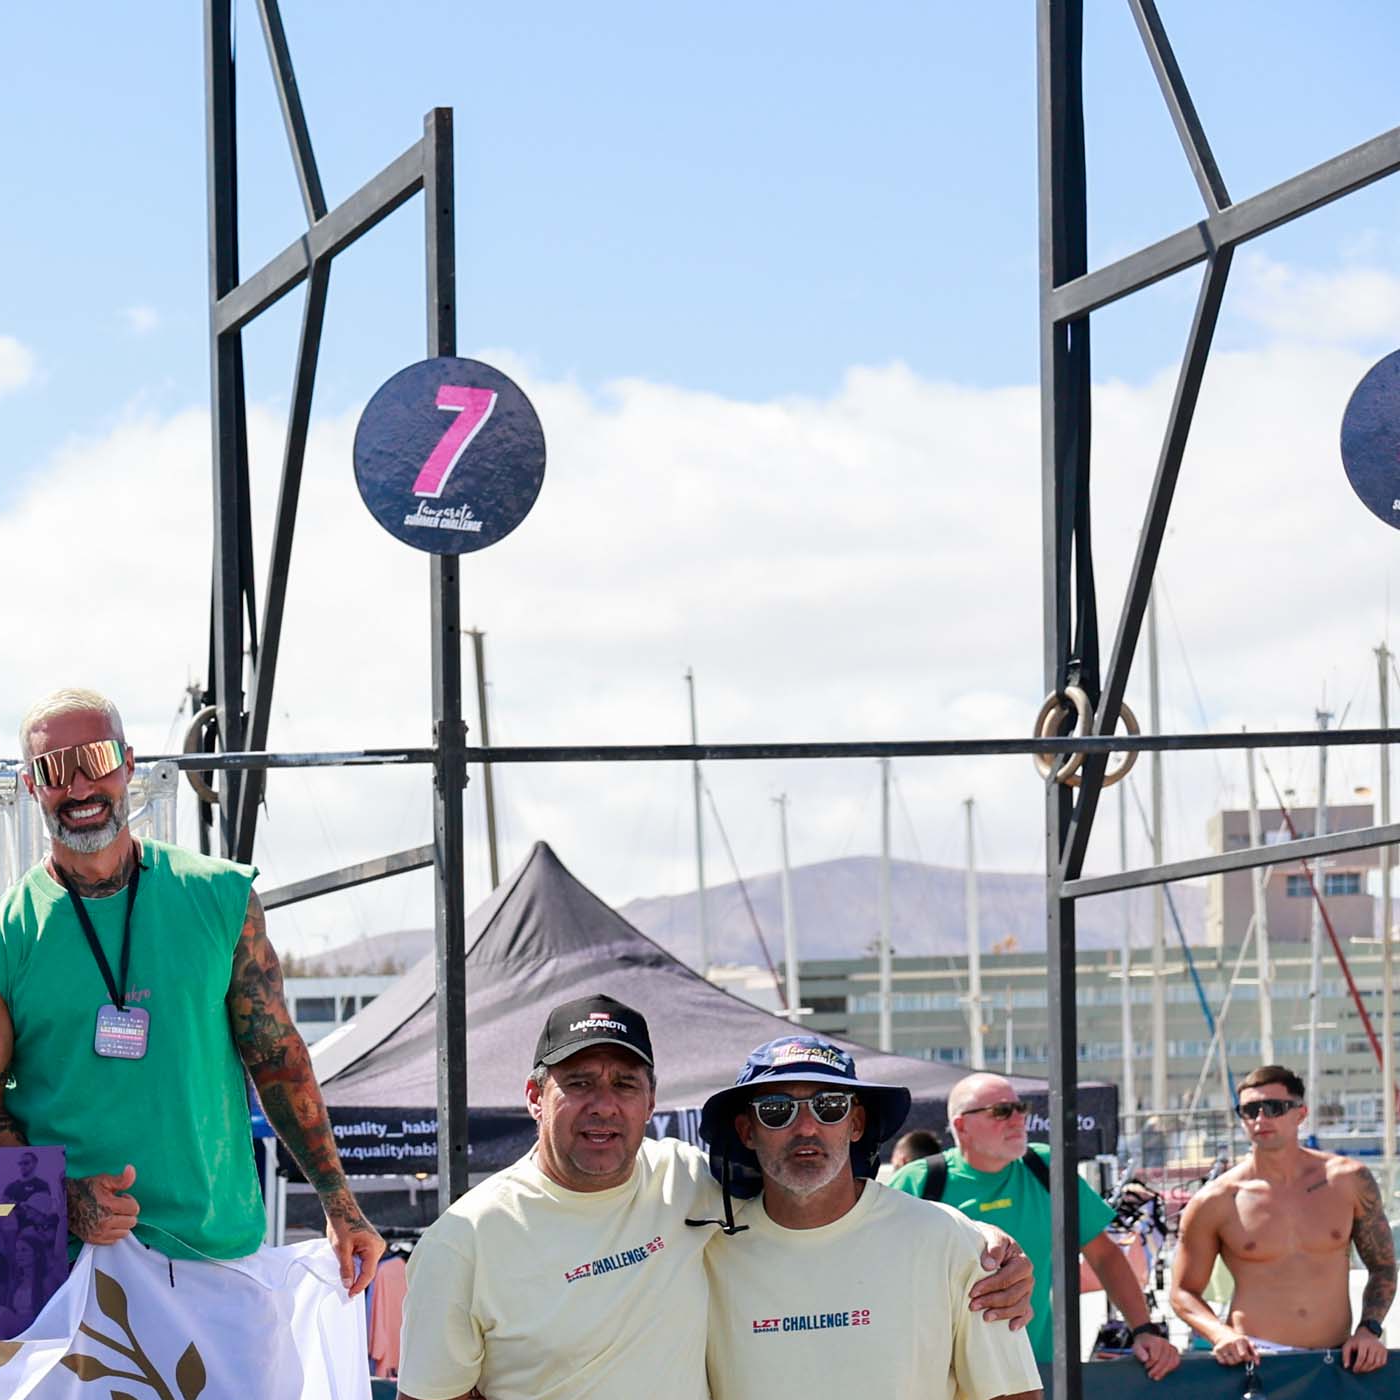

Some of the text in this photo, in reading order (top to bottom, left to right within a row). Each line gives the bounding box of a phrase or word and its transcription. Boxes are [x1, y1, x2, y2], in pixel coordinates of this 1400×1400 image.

[411, 384, 498, 498] 7
[404, 514, 483, 532] SUMMER CHALLENGE
[570, 1019, 628, 1034] LANZAROTE
[564, 1263, 592, 1280] LZT
[592, 1246, 649, 1276] CHALLENGE
[752, 1318, 782, 1328] LZT
[782, 1311, 850, 1332] CHALLENGE
